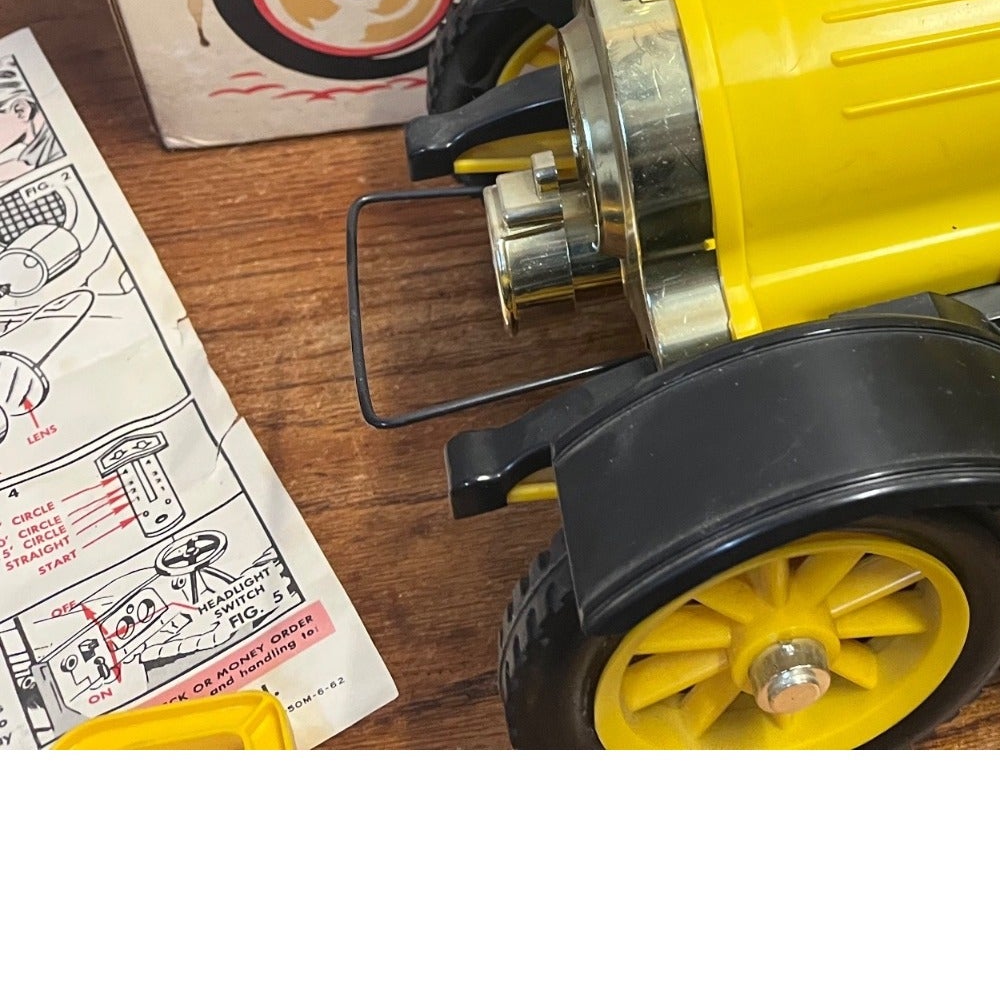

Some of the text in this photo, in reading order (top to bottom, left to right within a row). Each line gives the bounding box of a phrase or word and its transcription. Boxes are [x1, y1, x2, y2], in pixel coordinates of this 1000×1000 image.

[26, 424, 58, 445] LENS
[8, 488, 19, 498] 4
[11, 501, 55, 526] CIRCLE
[18, 515, 62, 539] CIRCLE
[23, 524, 67, 549] CIRCLE
[5, 535, 70, 571] STRAIGHT
[38, 549, 77, 575] START
[198, 567, 270, 615] HEADLIGHT
[214, 584, 265, 619] SWITCH
[51, 600, 77, 618] OFF
[228, 590, 284, 628] FIG. 5
[193, 678, 212, 694] OR
[216, 643, 264, 680] MONEY
[270, 615, 314, 645] ORDER
[210, 676, 235, 696] and
[239, 639, 297, 678] handling
[88, 687, 113, 704] ON
